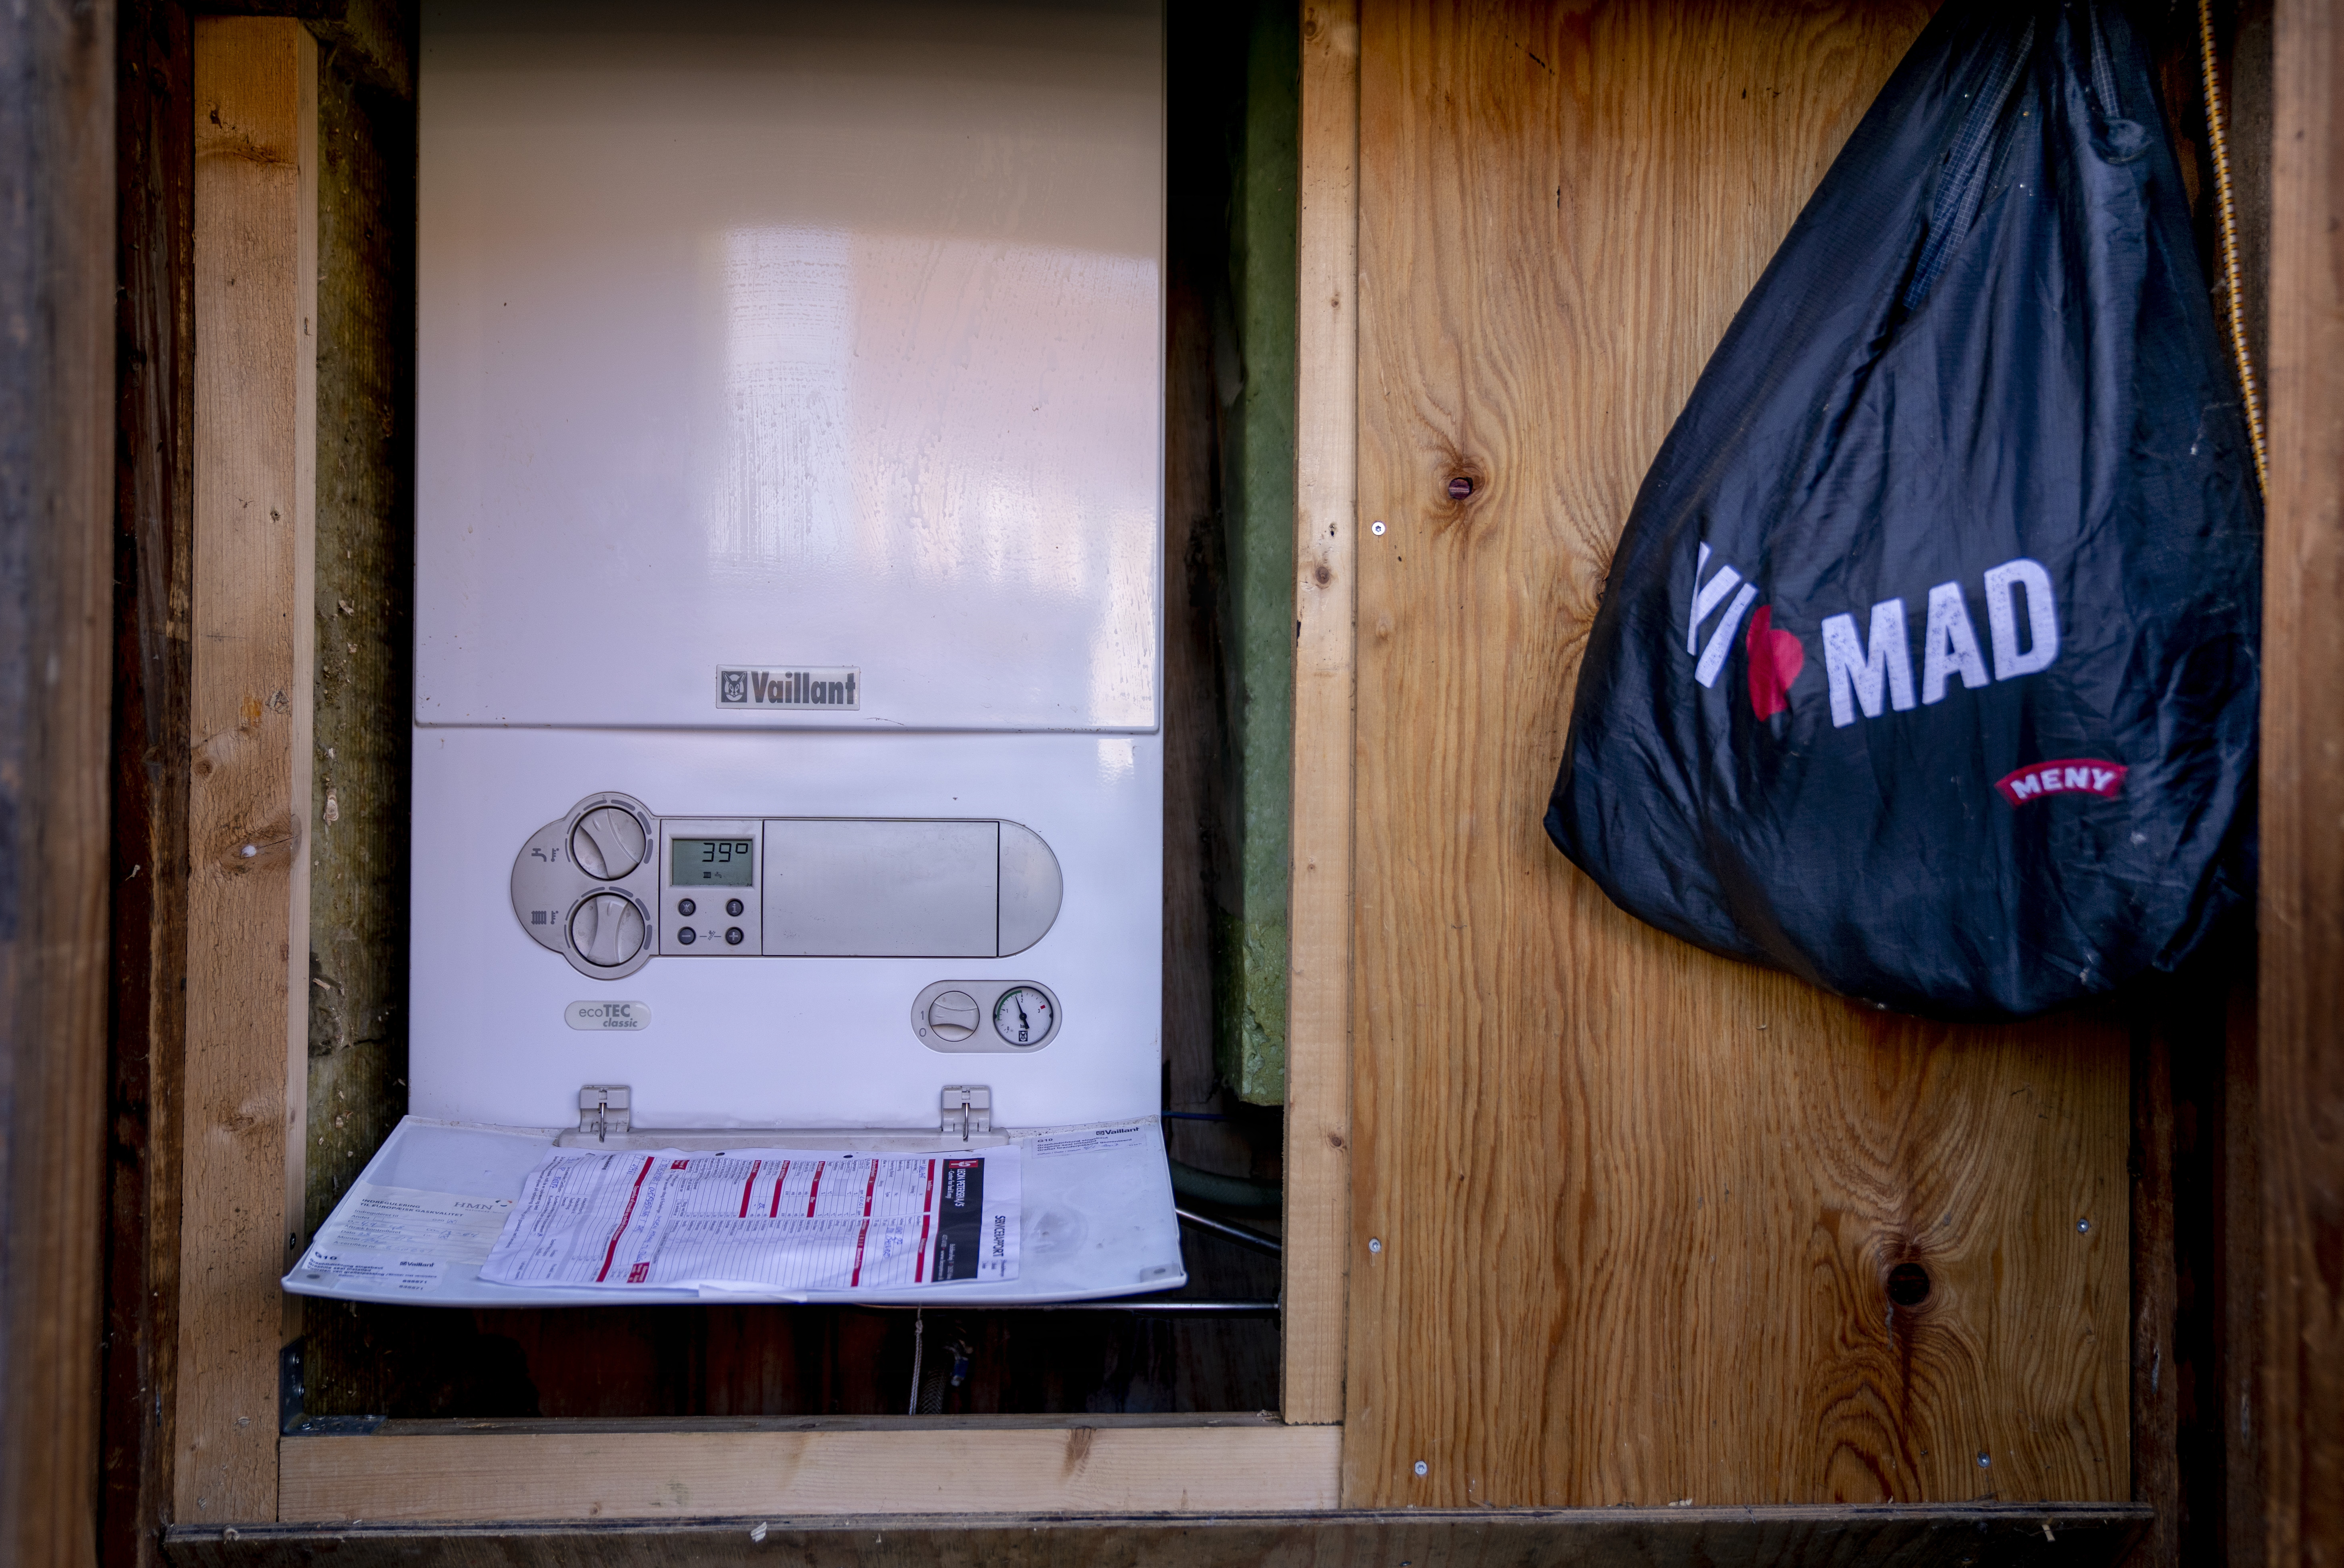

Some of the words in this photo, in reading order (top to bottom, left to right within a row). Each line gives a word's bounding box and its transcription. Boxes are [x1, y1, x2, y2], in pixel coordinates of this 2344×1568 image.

[1821, 558, 2060, 728] MAD
[751, 671, 855, 704] Vaillant
[2010, 766, 2114, 799] MENY
[579, 1004, 630, 1017] ecoTEC
[603, 1018, 637, 1027] classic
[957, 1169, 966, 1179] LEON
[362, 1199, 420, 1208] INDREGULERING
[453, 1202, 493, 1210] HMN
[992, 1215, 1006, 1257] SERVICERAPPORT
[315, 1252, 337, 1260] G10
